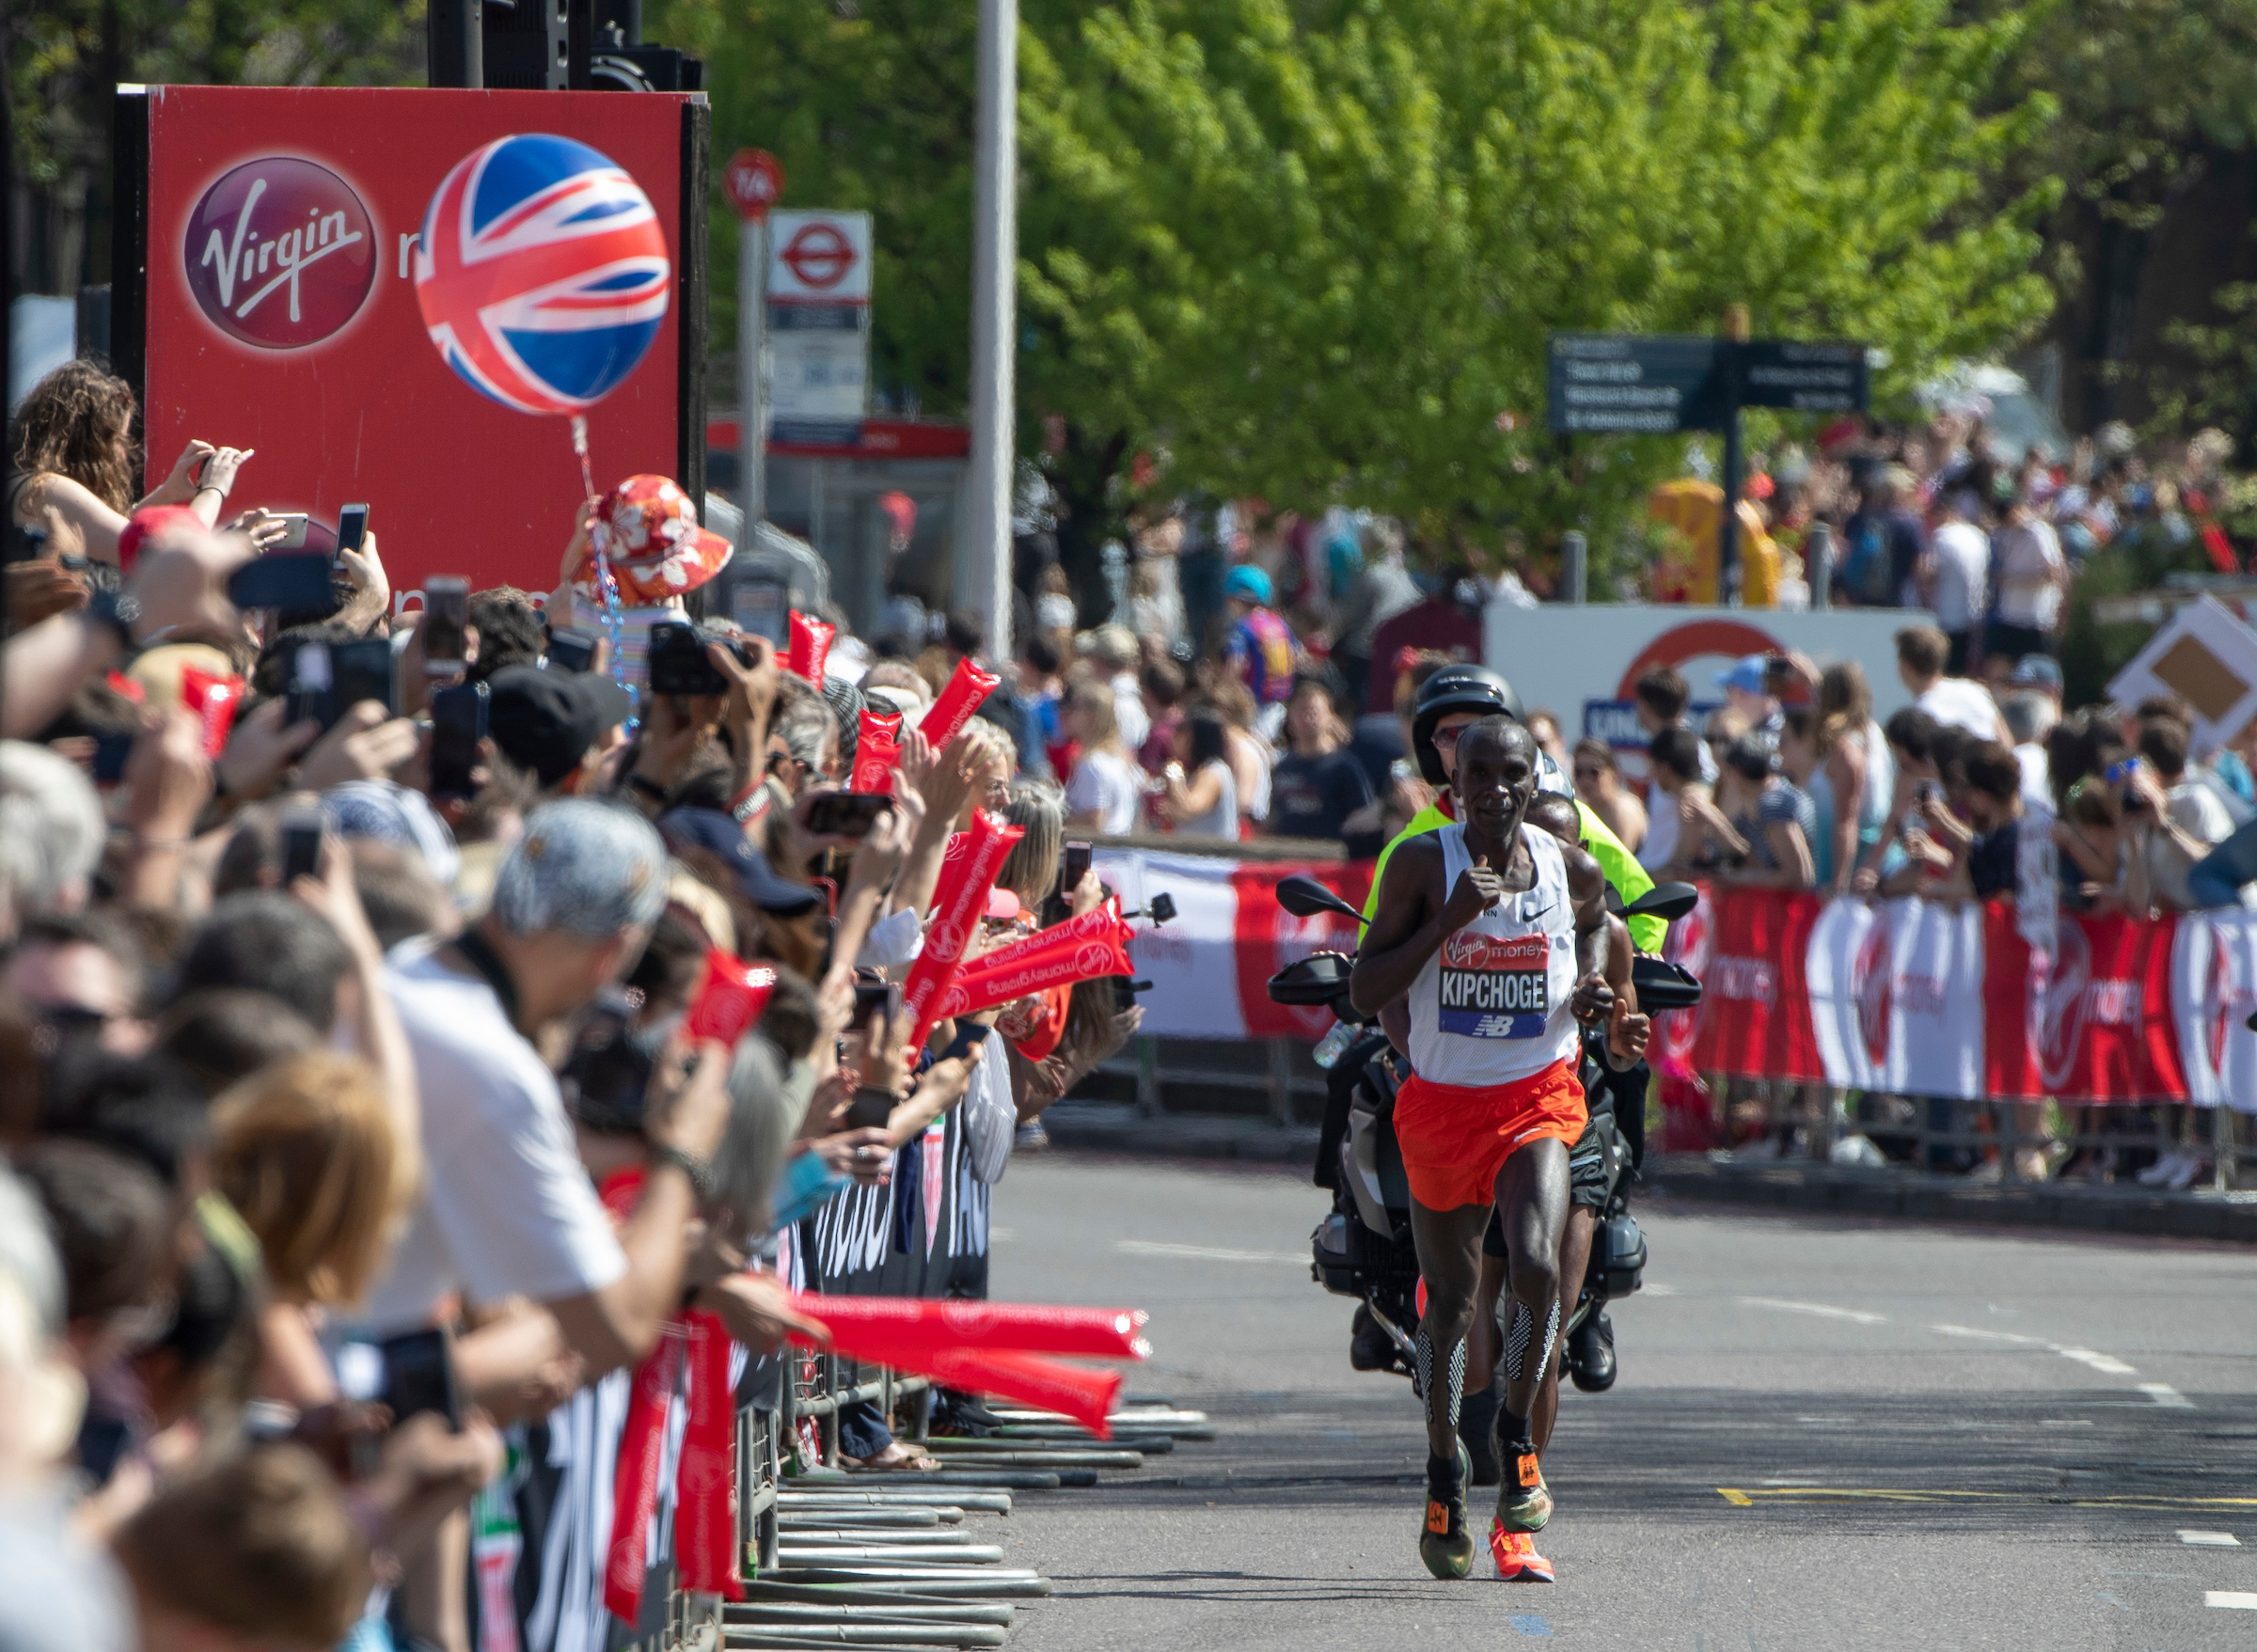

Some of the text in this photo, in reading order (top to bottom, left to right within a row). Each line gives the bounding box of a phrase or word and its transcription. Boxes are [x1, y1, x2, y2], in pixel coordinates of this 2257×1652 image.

[201, 179, 363, 322] Virgin
[1448, 931, 1543, 966] Virgin money
[1442, 971, 1544, 1009] KIPCHOGE
